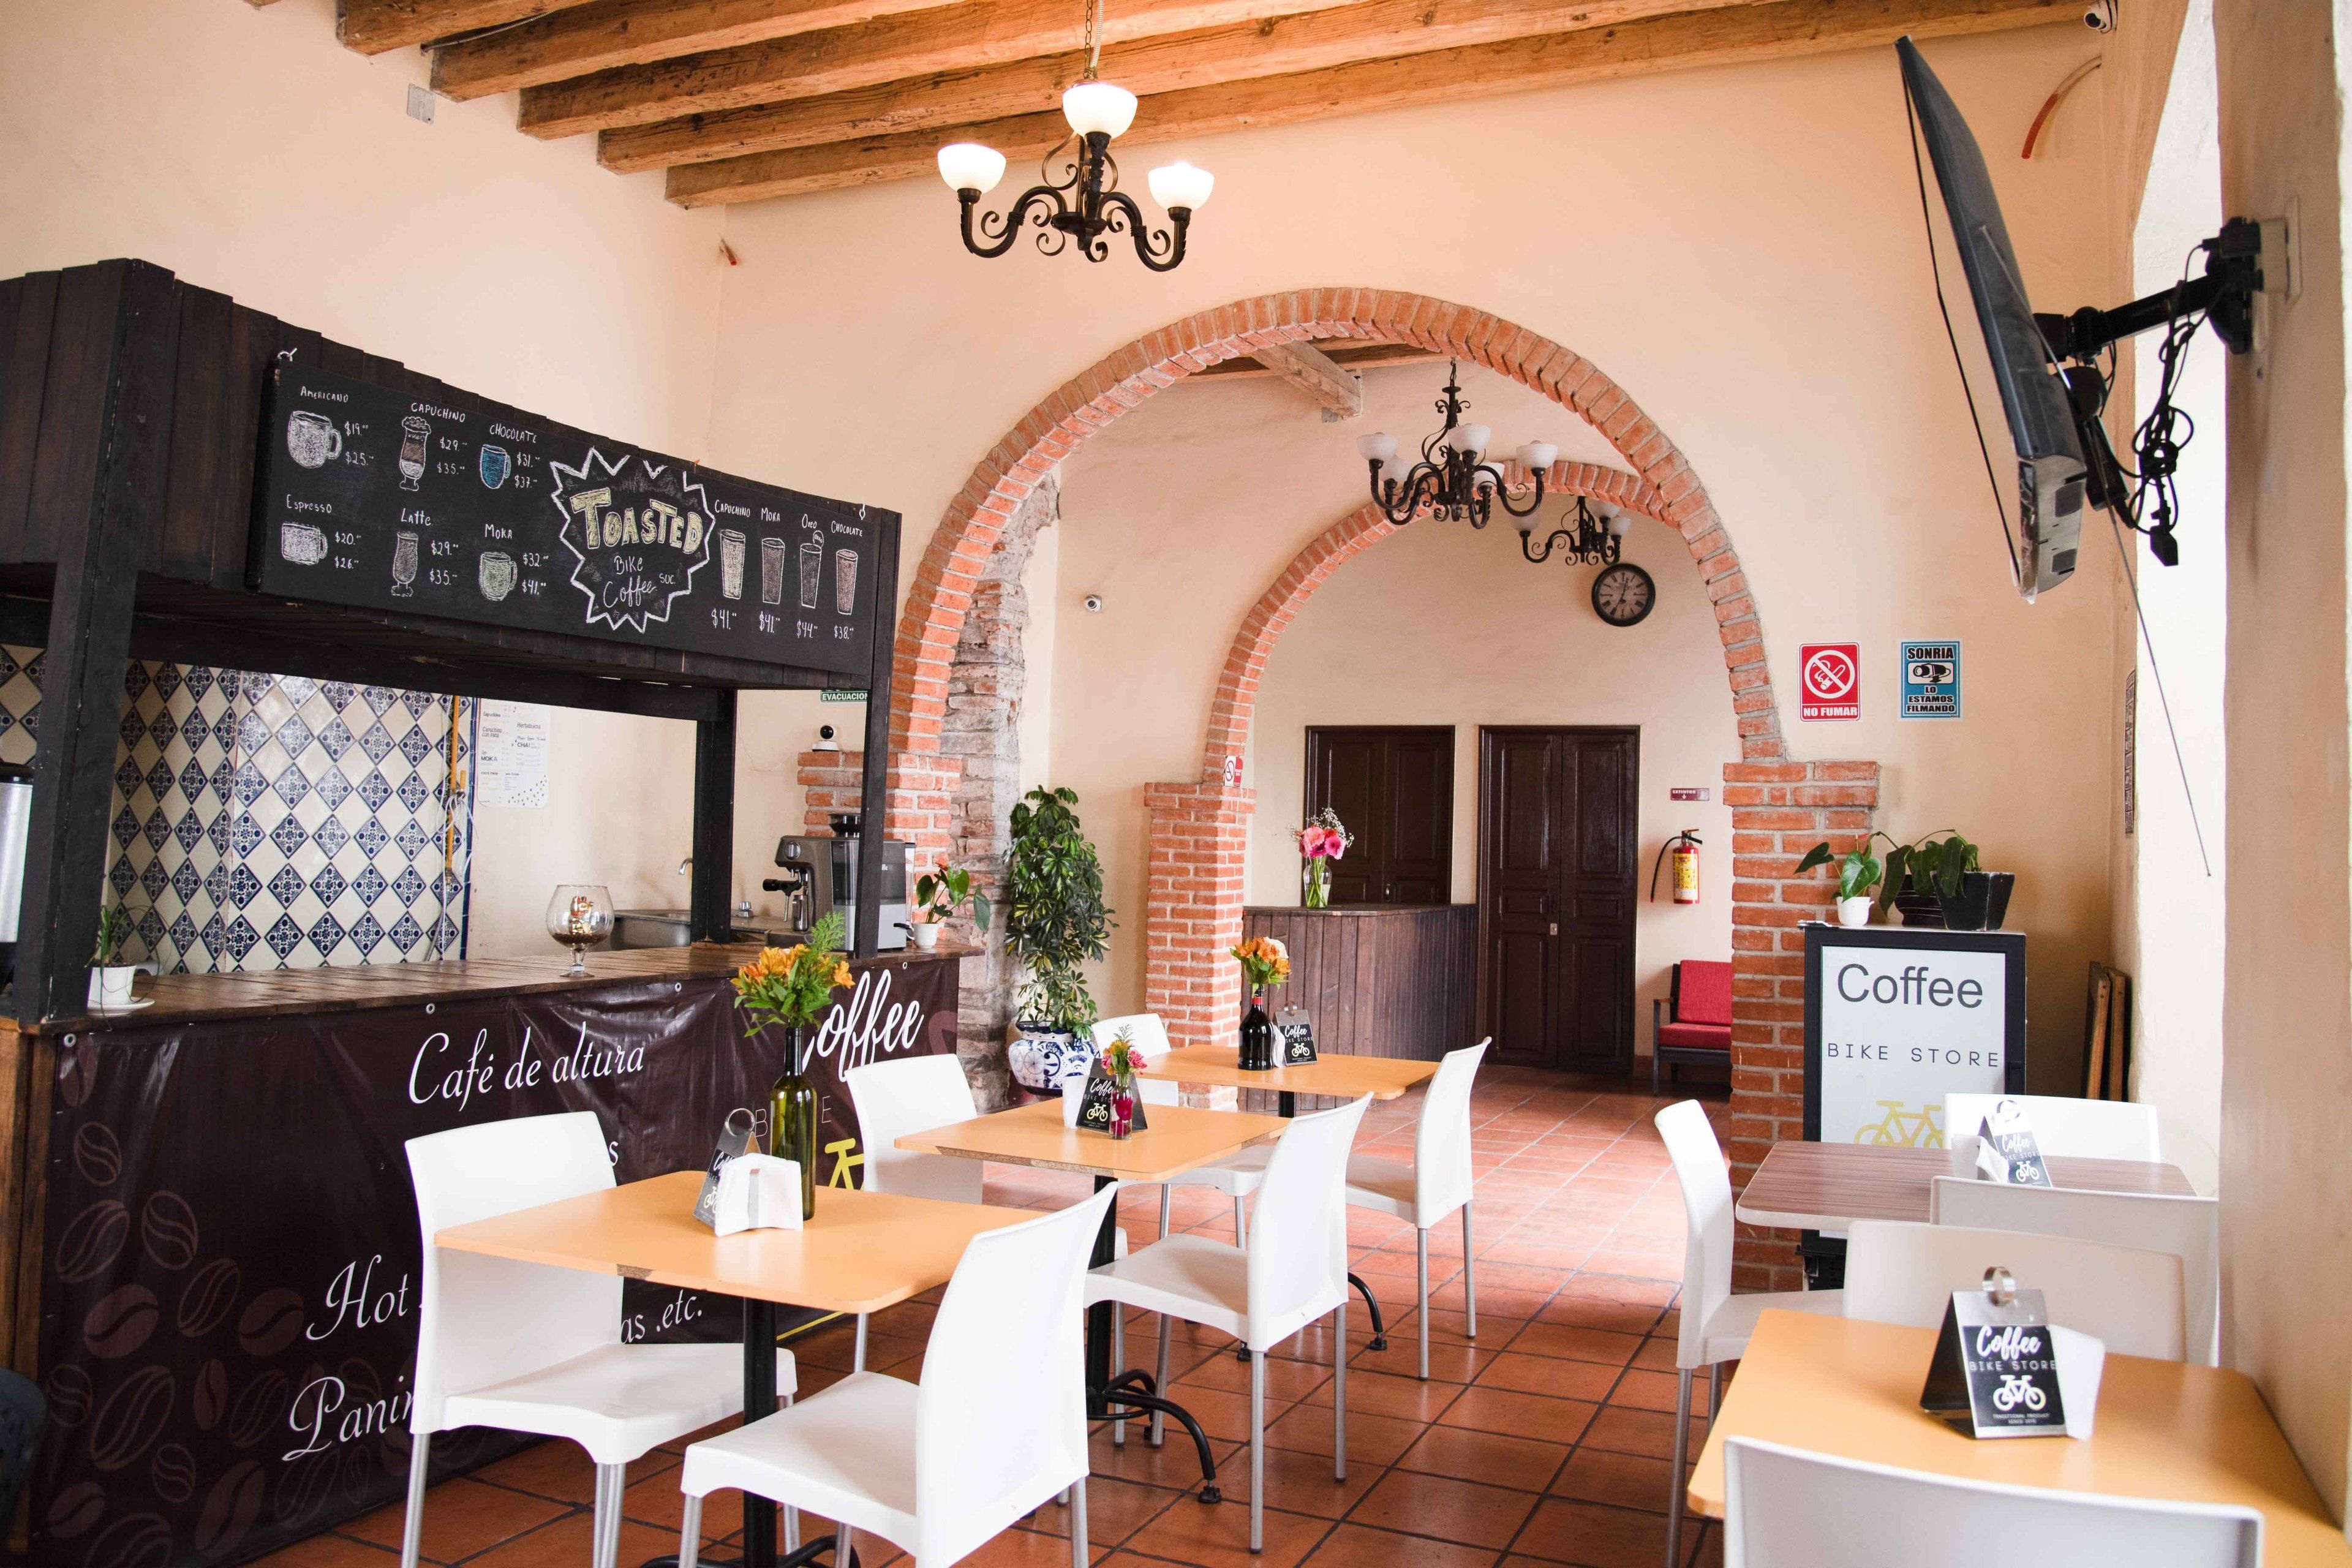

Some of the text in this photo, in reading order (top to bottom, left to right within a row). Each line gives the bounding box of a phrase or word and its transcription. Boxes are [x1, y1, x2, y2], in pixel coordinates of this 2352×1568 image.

[411, 402, 466, 423] CAPUCHINO
[490, 423, 537, 443] CHOCOLATE
[287, 494, 332, 513] Espresso
[715, 499, 751, 518] CAPUCHINO
[569, 487, 703, 554] TOASTED
[831, 521, 864, 537] CHOCOLATE
[1907, 647, 1954, 659] SONRIA
[1803, 706, 1858, 717] NO FUMAR
[1838, 963, 1983, 1009] Coffee
[1284, 1025, 1308, 1038] Coffee
[1828, 1043, 1999, 1068] BIKE STORE
[409, 1020, 644, 1112] Café de altura
[1090, 1078, 1114, 1096] Coffe
[306, 1254, 408, 1340] Hot
[1977, 1324, 2041, 1360] Coffee
[1969, 1360, 2057, 1371] BIKE STORE
